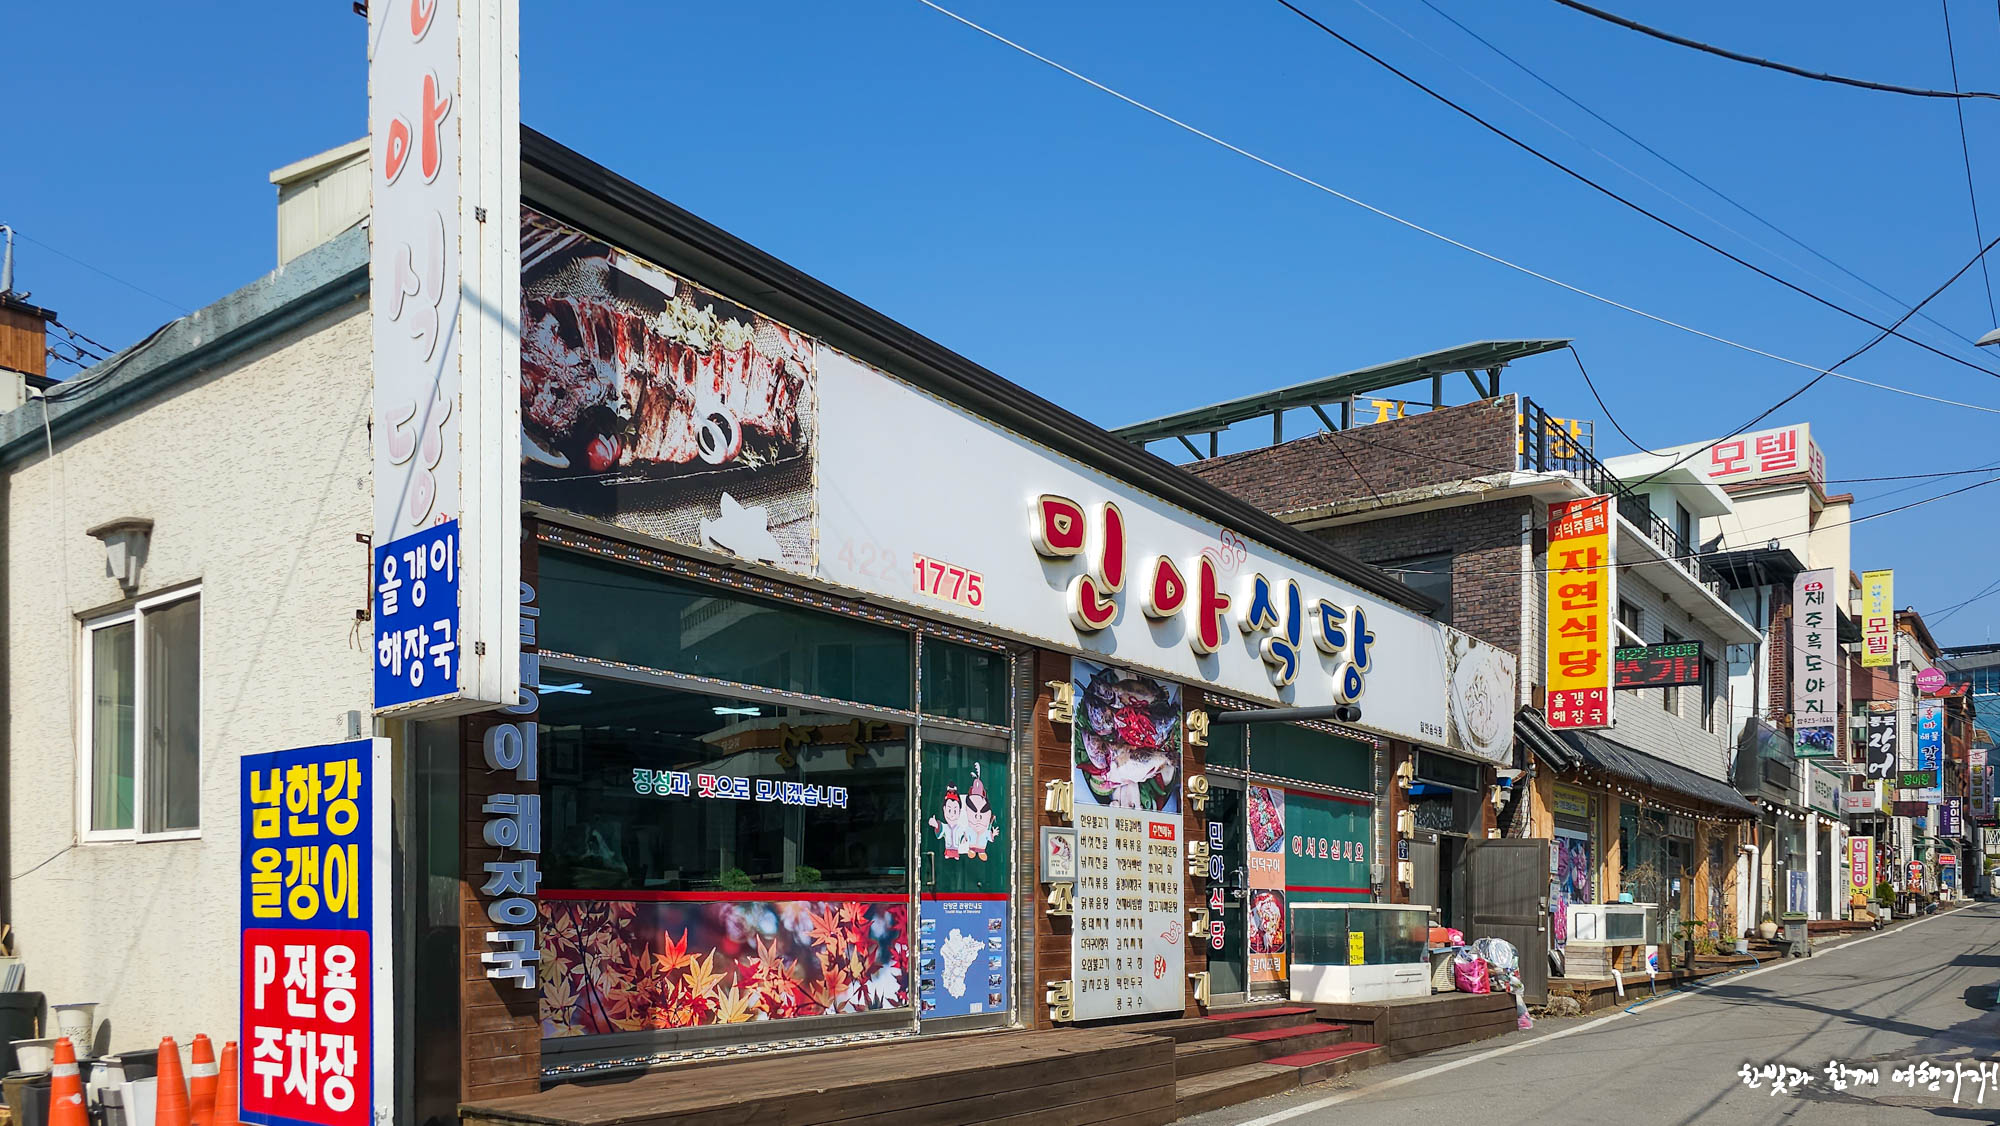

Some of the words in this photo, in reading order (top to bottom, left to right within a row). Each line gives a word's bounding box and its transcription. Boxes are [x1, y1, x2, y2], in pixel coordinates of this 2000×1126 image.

[1707, 430, 1797, 477] 모텔
[1554, 514, 1604, 538] 더덕주물럭
[379, 534, 455, 615] 올갱이
[915, 558, 982, 606] 1775
[1030, 494, 1376, 704] 민아식당
[1558, 546, 1602, 678] 자연식당
[1866, 617, 1889, 654] 모텔
[379, 619, 455, 689] 해장국
[1805, 591, 1825, 713] 제주흑도야지
[1553, 690, 1603, 708] 올갱이
[1553, 709, 1603, 724] 해장국
[1869, 727, 1896, 778] 장어
[250, 758, 362, 839] 남한강
[633, 768, 691, 796] 정성과
[697, 774, 750, 800] 맛으로
[756, 779, 848, 808] 모시겠습니다
[1950, 799, 1961, 835] 와이모텔
[1251, 856, 1280, 873] 더덕구이
[1292, 835, 1364, 862] 어서오십시오
[1854, 841, 1867, 885] 아젤리아
[251, 844, 359, 920] 올갱이
[1209, 821, 1225, 950] 민아식당
[254, 945, 276, 1010] P
[283, 944, 357, 1024] 전용
[253, 1026, 358, 1112] 주차장
